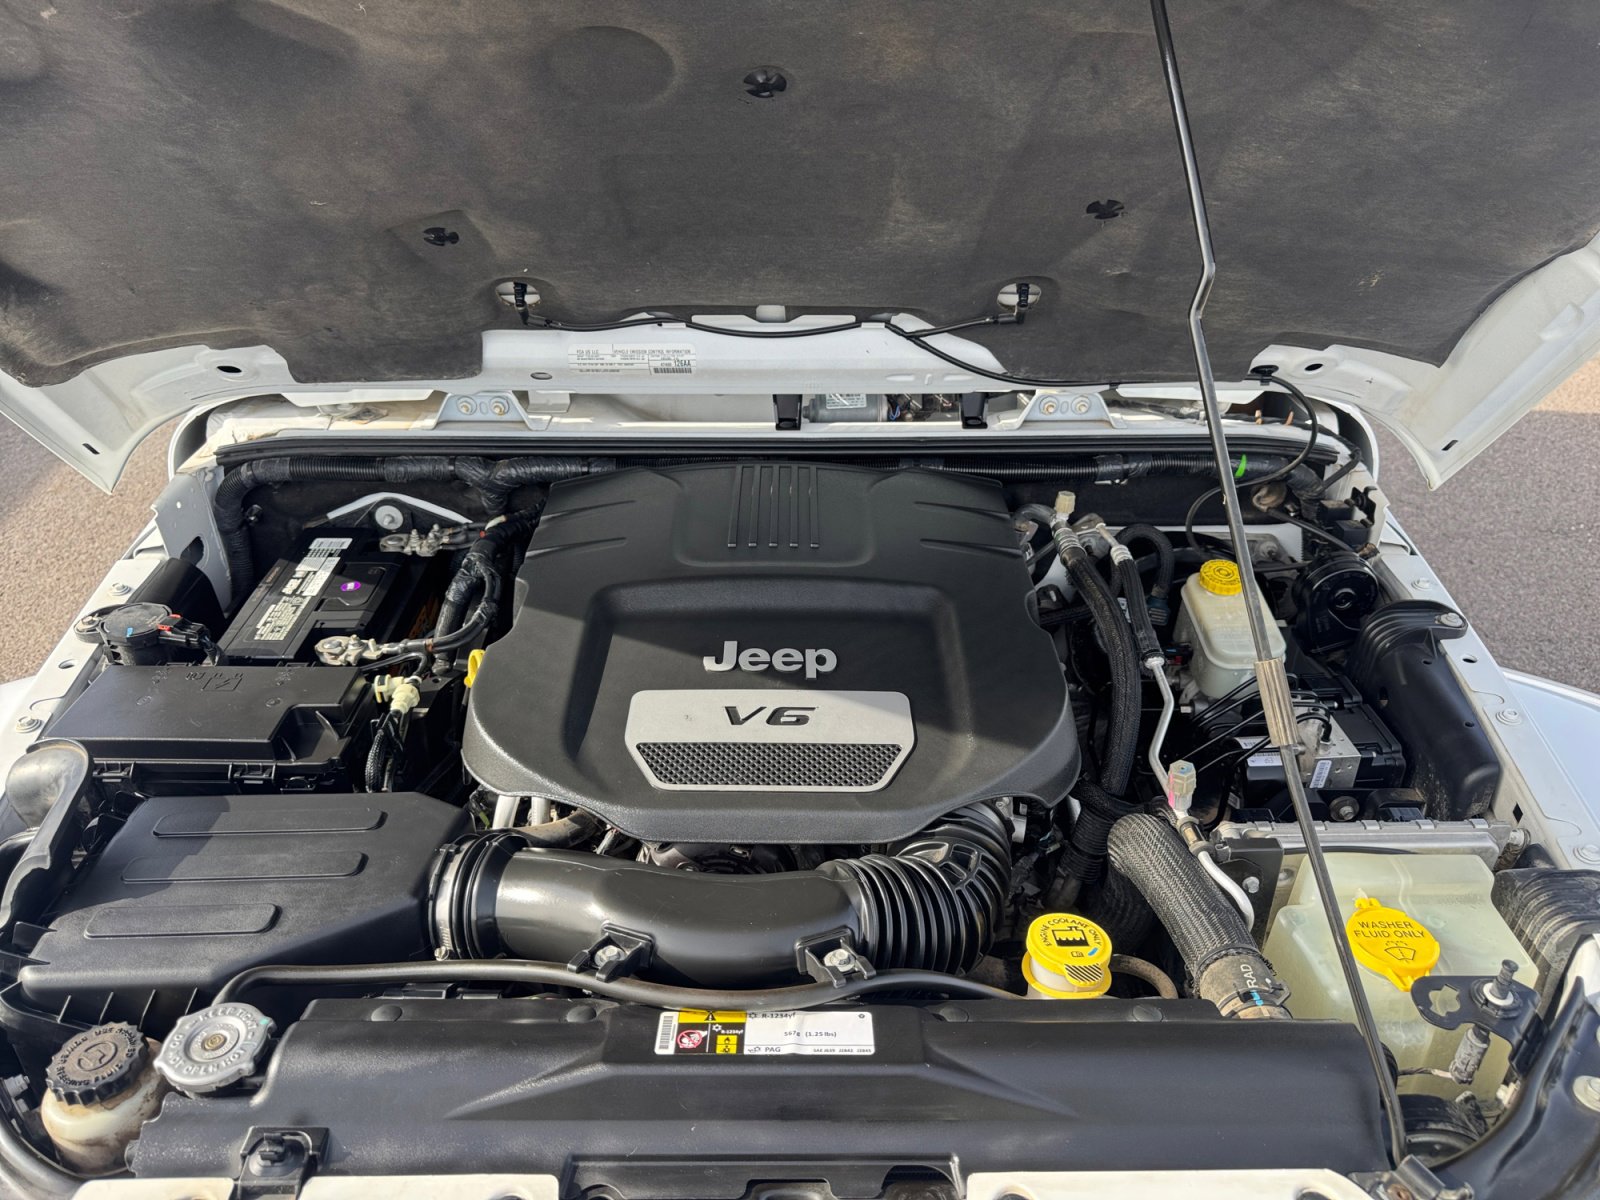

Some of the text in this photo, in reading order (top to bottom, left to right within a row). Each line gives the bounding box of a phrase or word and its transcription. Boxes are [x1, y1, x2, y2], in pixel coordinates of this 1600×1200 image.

[703, 640, 837, 679] Jeep
[724, 706, 817, 726] V6
[1040, 917, 1102, 947] ENGINE COOLANT ONLY
[1353, 930, 1425, 938] FLUID ONLY
[1240, 963, 1259, 988] RAD
